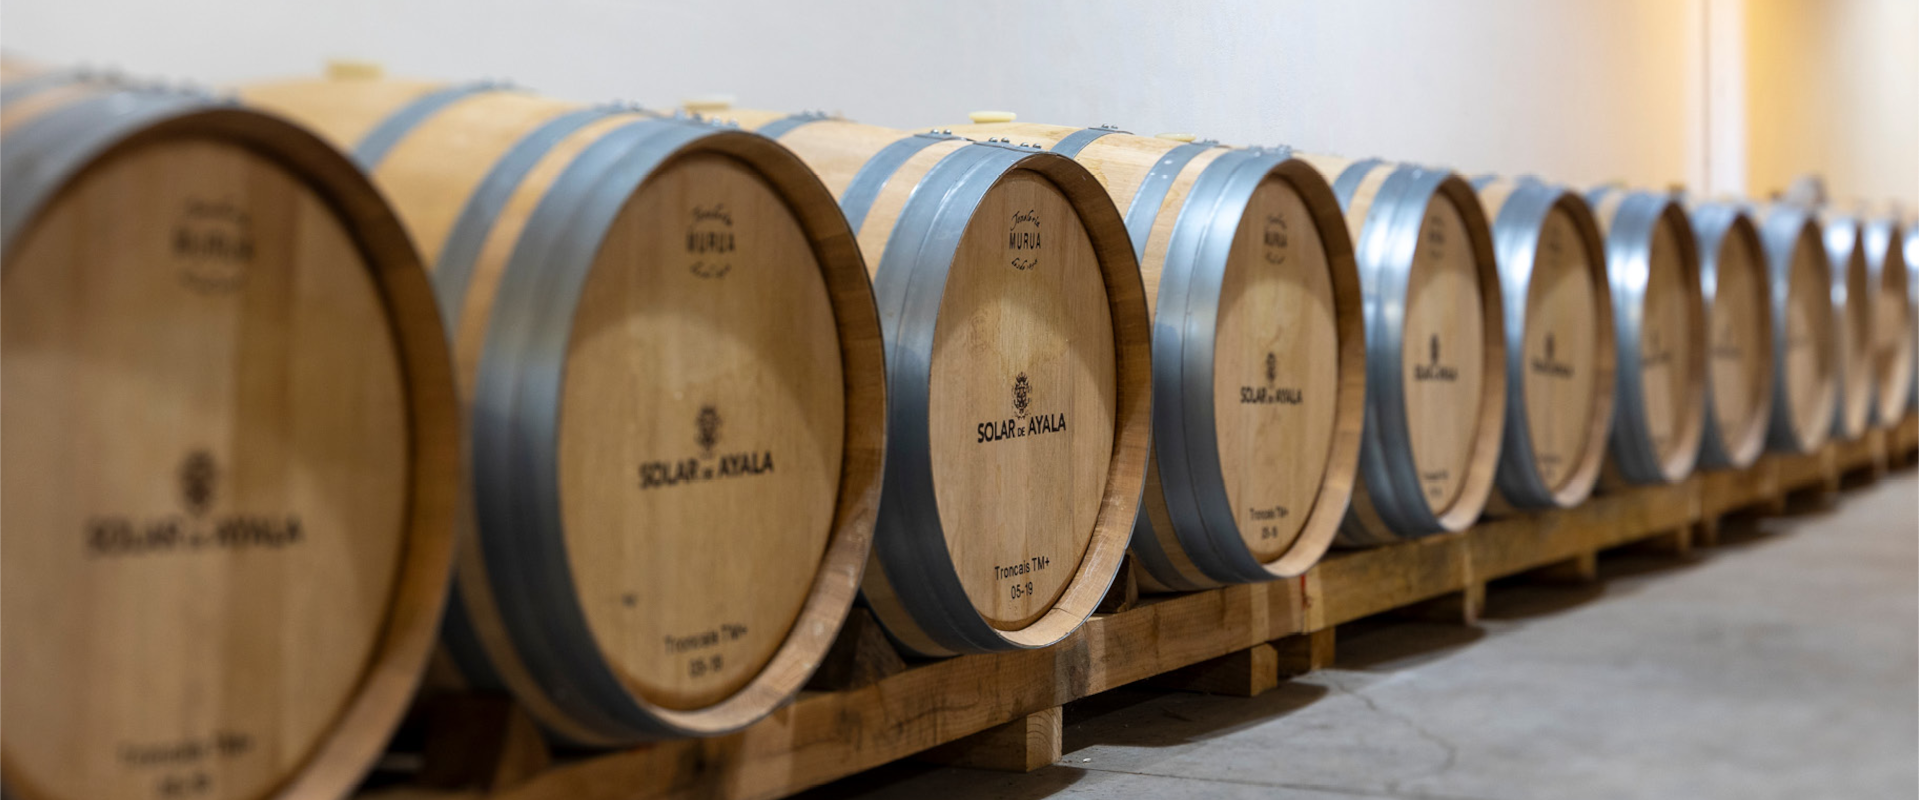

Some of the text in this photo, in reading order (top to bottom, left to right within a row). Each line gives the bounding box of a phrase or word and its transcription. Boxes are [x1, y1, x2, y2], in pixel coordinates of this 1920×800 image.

[1009, 232, 1041, 250] MURUA
[1240, 385, 1267, 405] SOLAR
[977, 412, 1066, 443] SOLAR DE AYALA
[638, 456, 699, 490] SOLAR
[717, 450, 775, 478] AYALA
[994, 556, 1050, 580] Troncais TM+
[1011, 581, 1033, 599] 05-19
